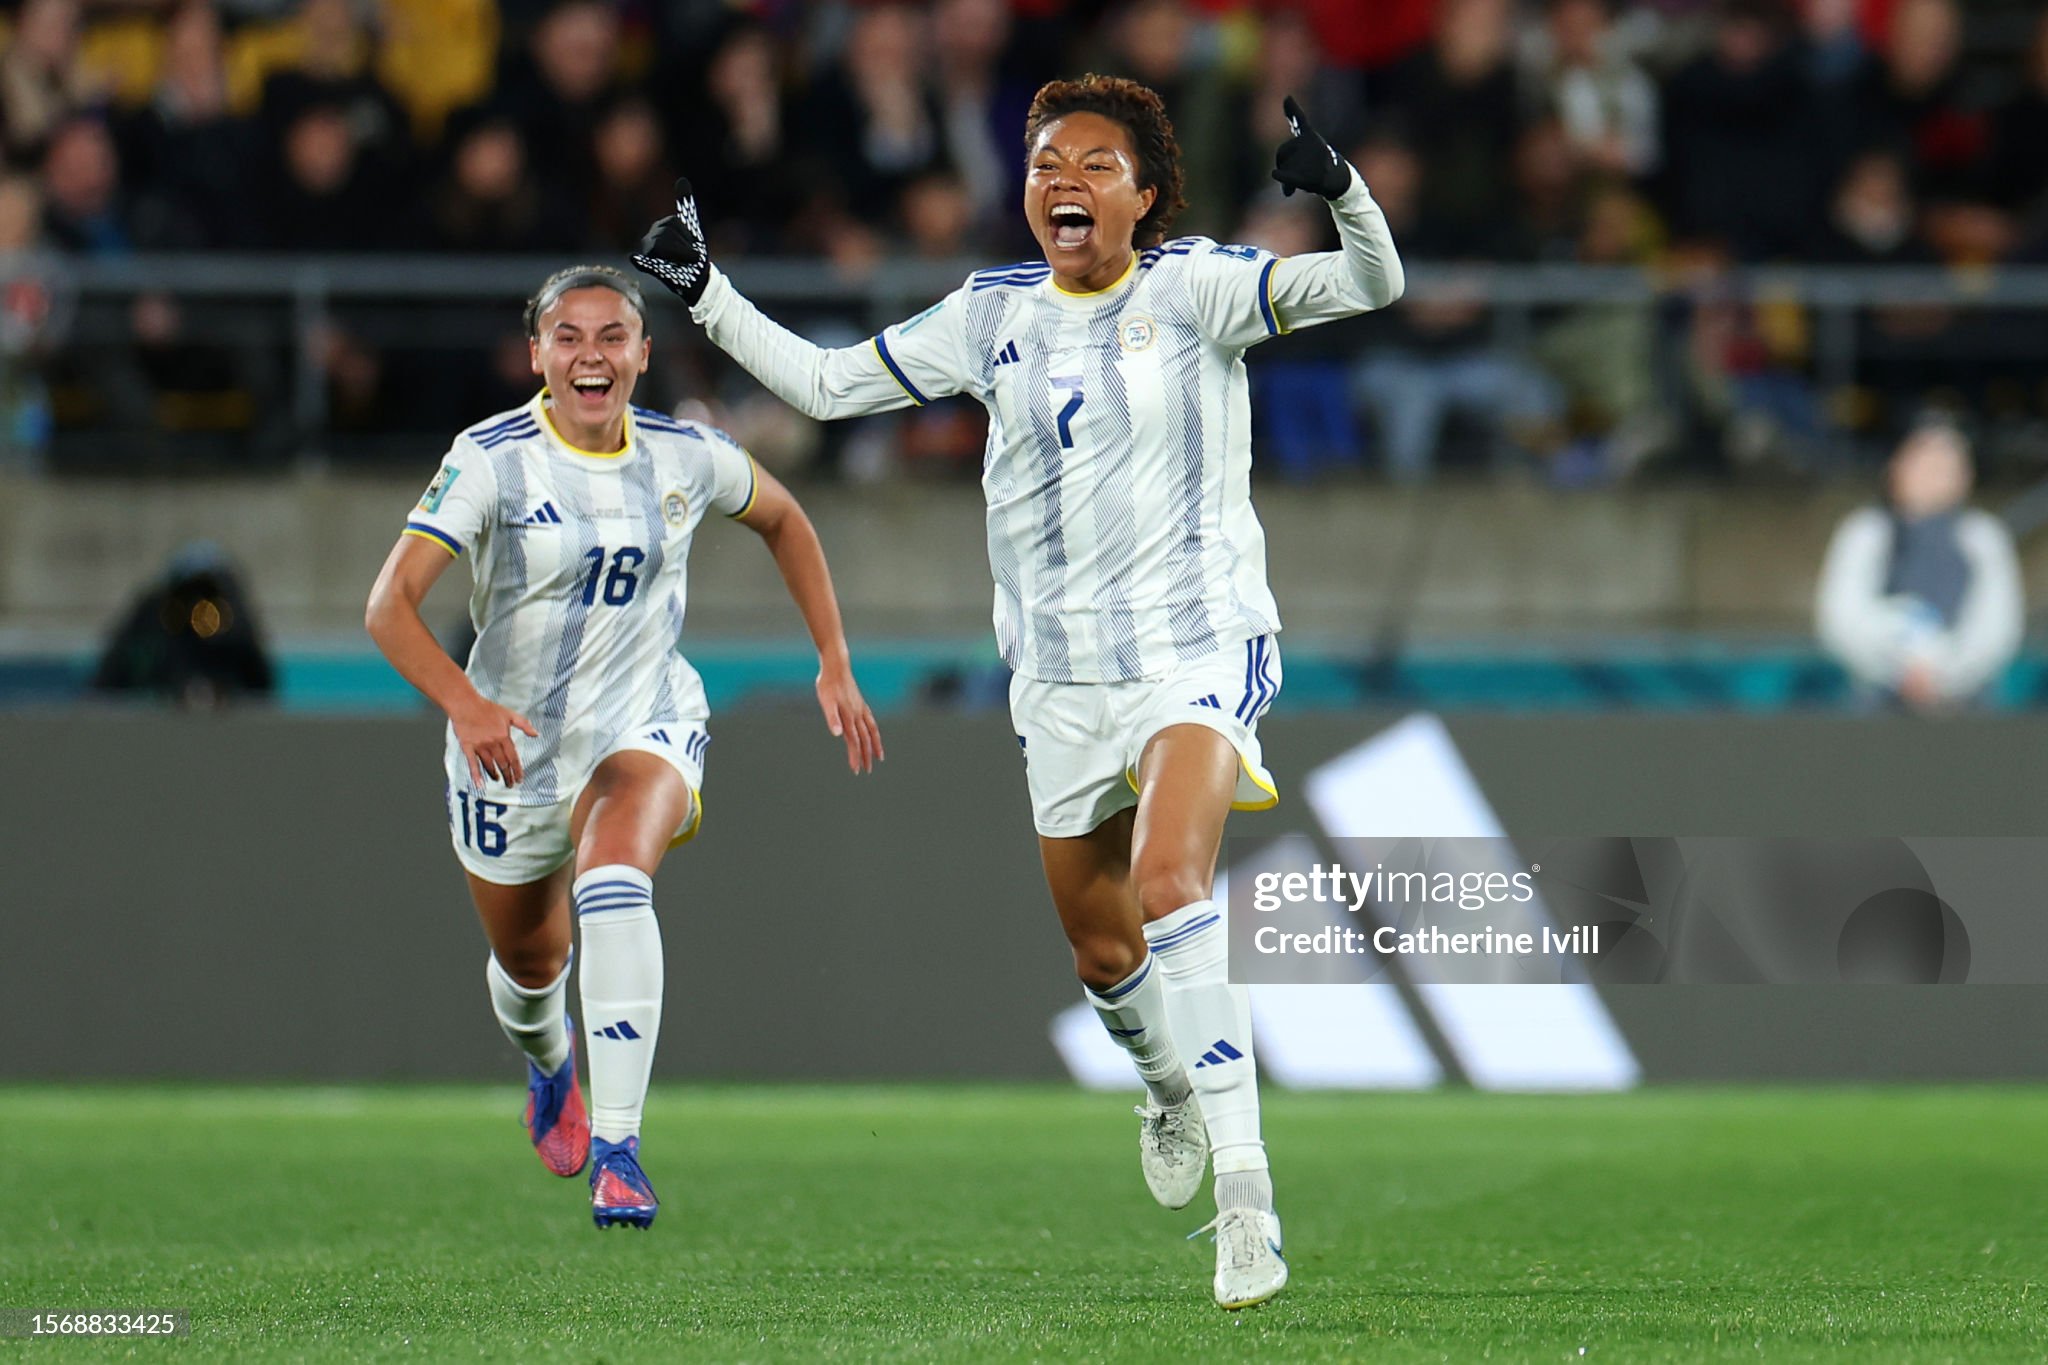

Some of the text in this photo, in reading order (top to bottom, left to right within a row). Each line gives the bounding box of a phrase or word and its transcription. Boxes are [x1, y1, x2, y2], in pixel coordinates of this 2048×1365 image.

[1050, 375, 1084, 449] 7
[582, 546, 645, 607] 16
[457, 790, 508, 858] 16
